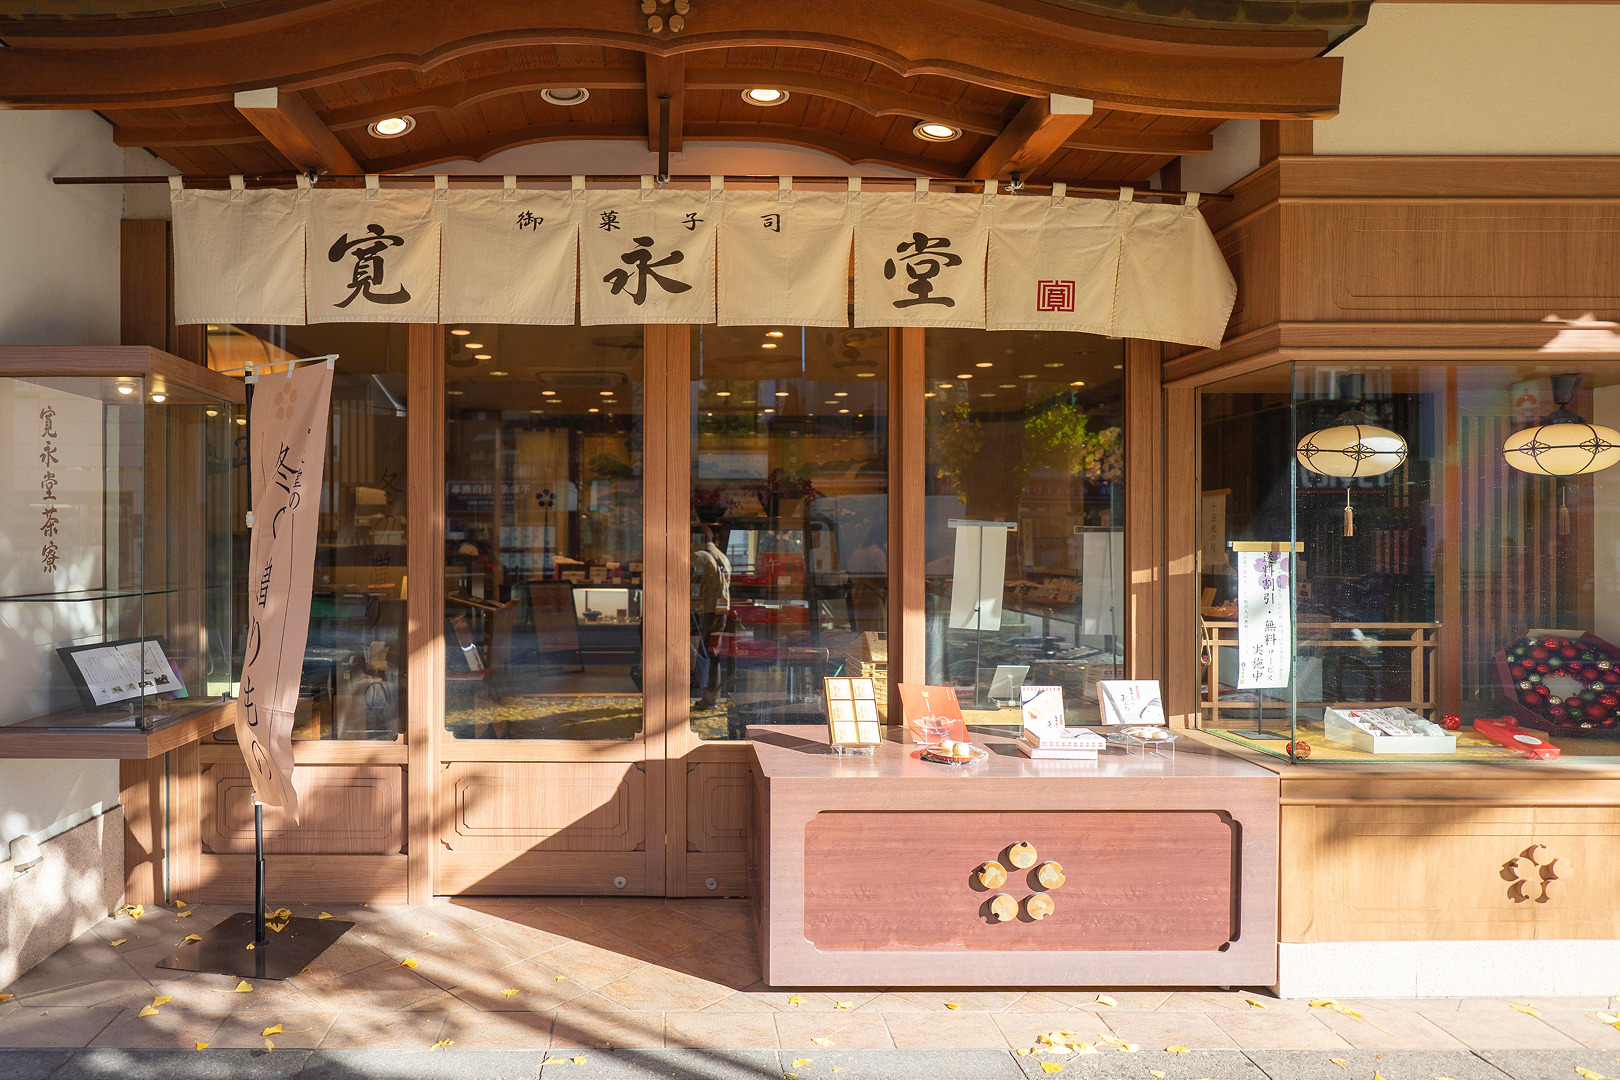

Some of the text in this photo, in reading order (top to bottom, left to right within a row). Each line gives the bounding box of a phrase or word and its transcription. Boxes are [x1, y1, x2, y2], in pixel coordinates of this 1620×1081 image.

[328, 223, 962, 309] 寛永堂
[39, 405, 60, 573] 寛永堂茶寮
[1209, 501, 1218, 553] 十五夜の月
[1252, 643, 1265, 682] 実施中
